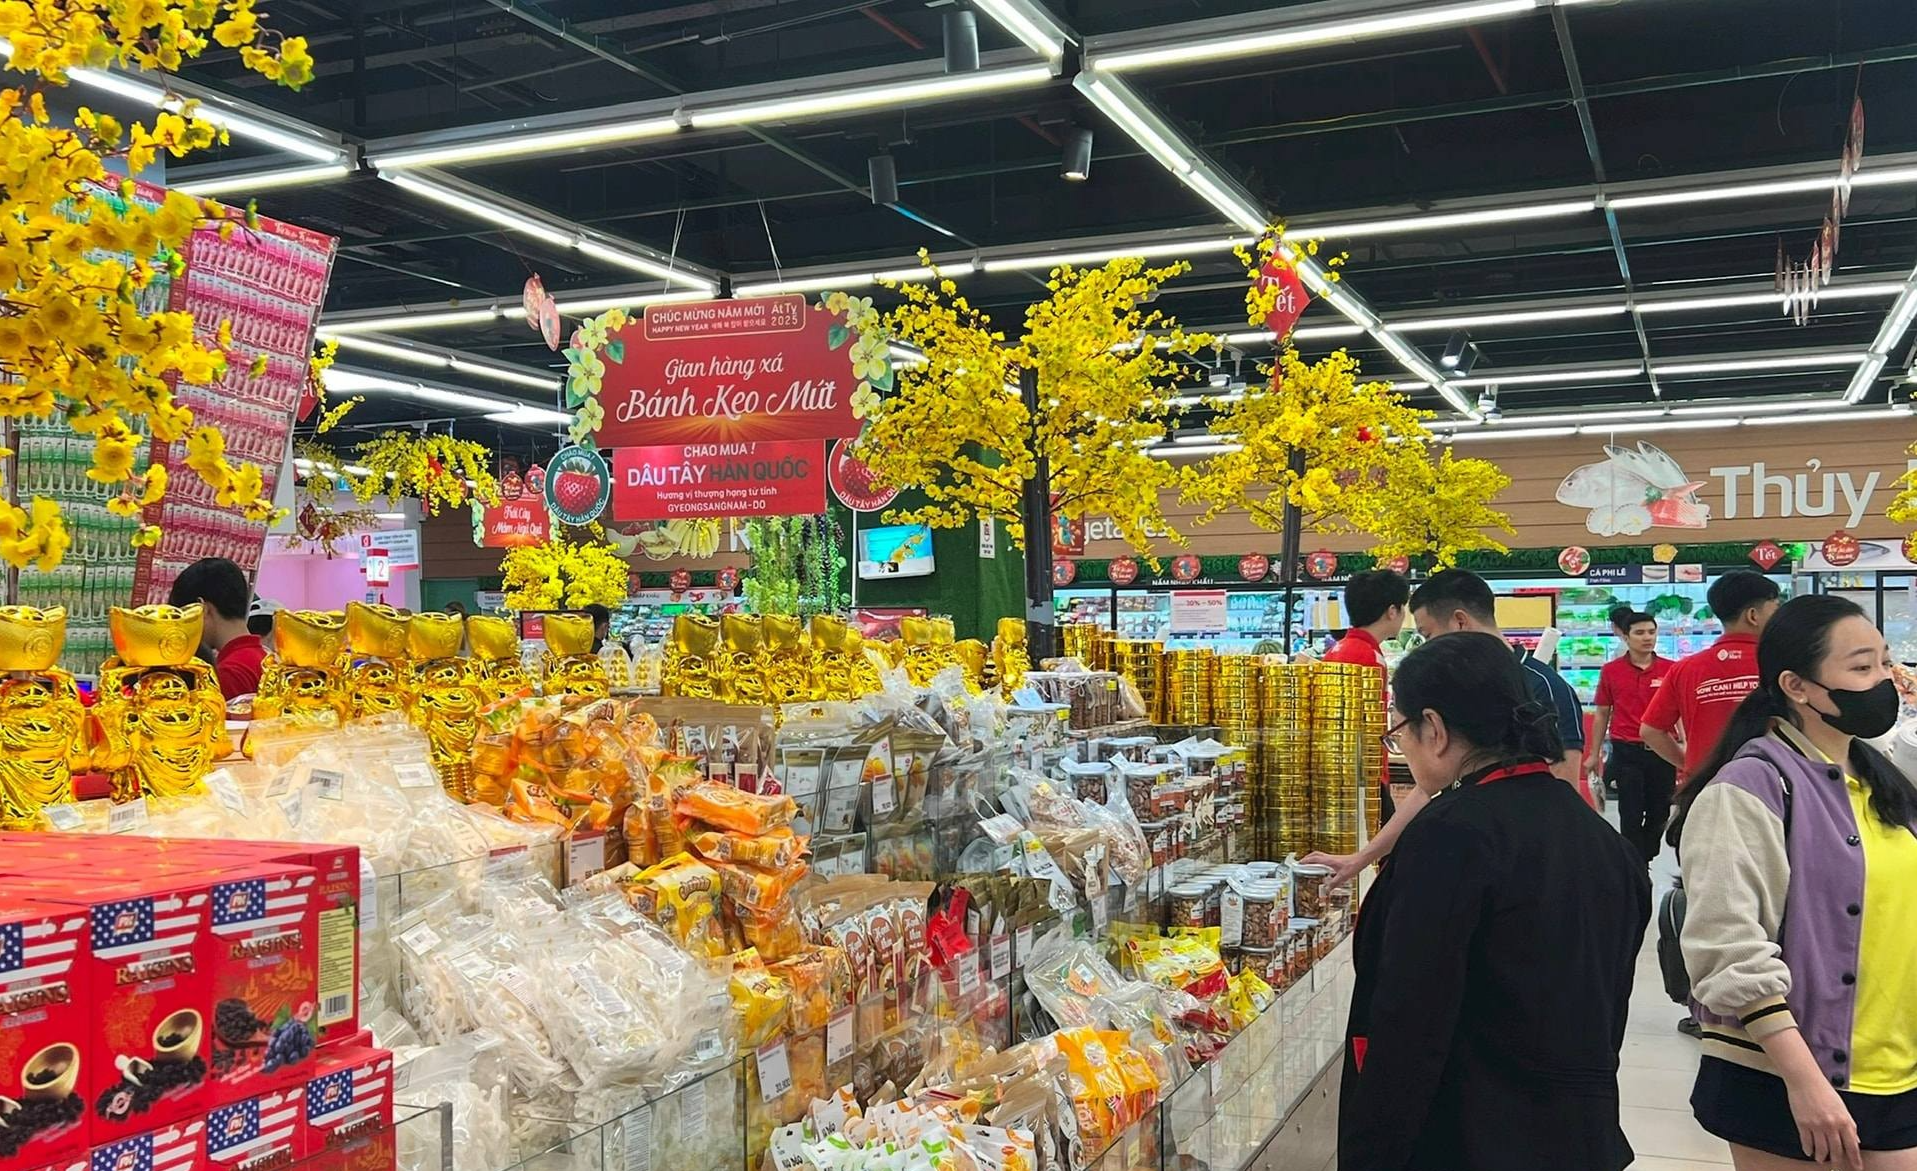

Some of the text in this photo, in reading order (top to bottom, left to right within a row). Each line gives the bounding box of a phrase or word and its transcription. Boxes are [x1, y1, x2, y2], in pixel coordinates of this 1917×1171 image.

[652, 310, 682, 324] CHÚC
[683, 305, 716, 321] MỪNG
[744, 303, 765, 317] MỚI
[771, 314, 798, 327] 2025
[652, 322, 709, 334] HAPPY NEW YEAR
[665, 352, 783, 385] Gian hàng xá
[616, 387, 698, 423] Bánh
[627, 463, 666, 487] DÂU
[668, 460, 707, 485] TÂY
[709, 459, 749, 482] HÀN
[1709, 458, 1881, 529] Thủy
[667, 499, 766, 513] GYEONGSANGNAM-DO
[1589, 567, 1602, 577] CÁ
[1602, 568, 1616, 577] PHI
[1712, 683, 1728, 692] CAN
[1732, 681, 1748, 690] HELP
[1748, 681, 1760, 690] YO
[115, 955, 194, 986] RAISINS
